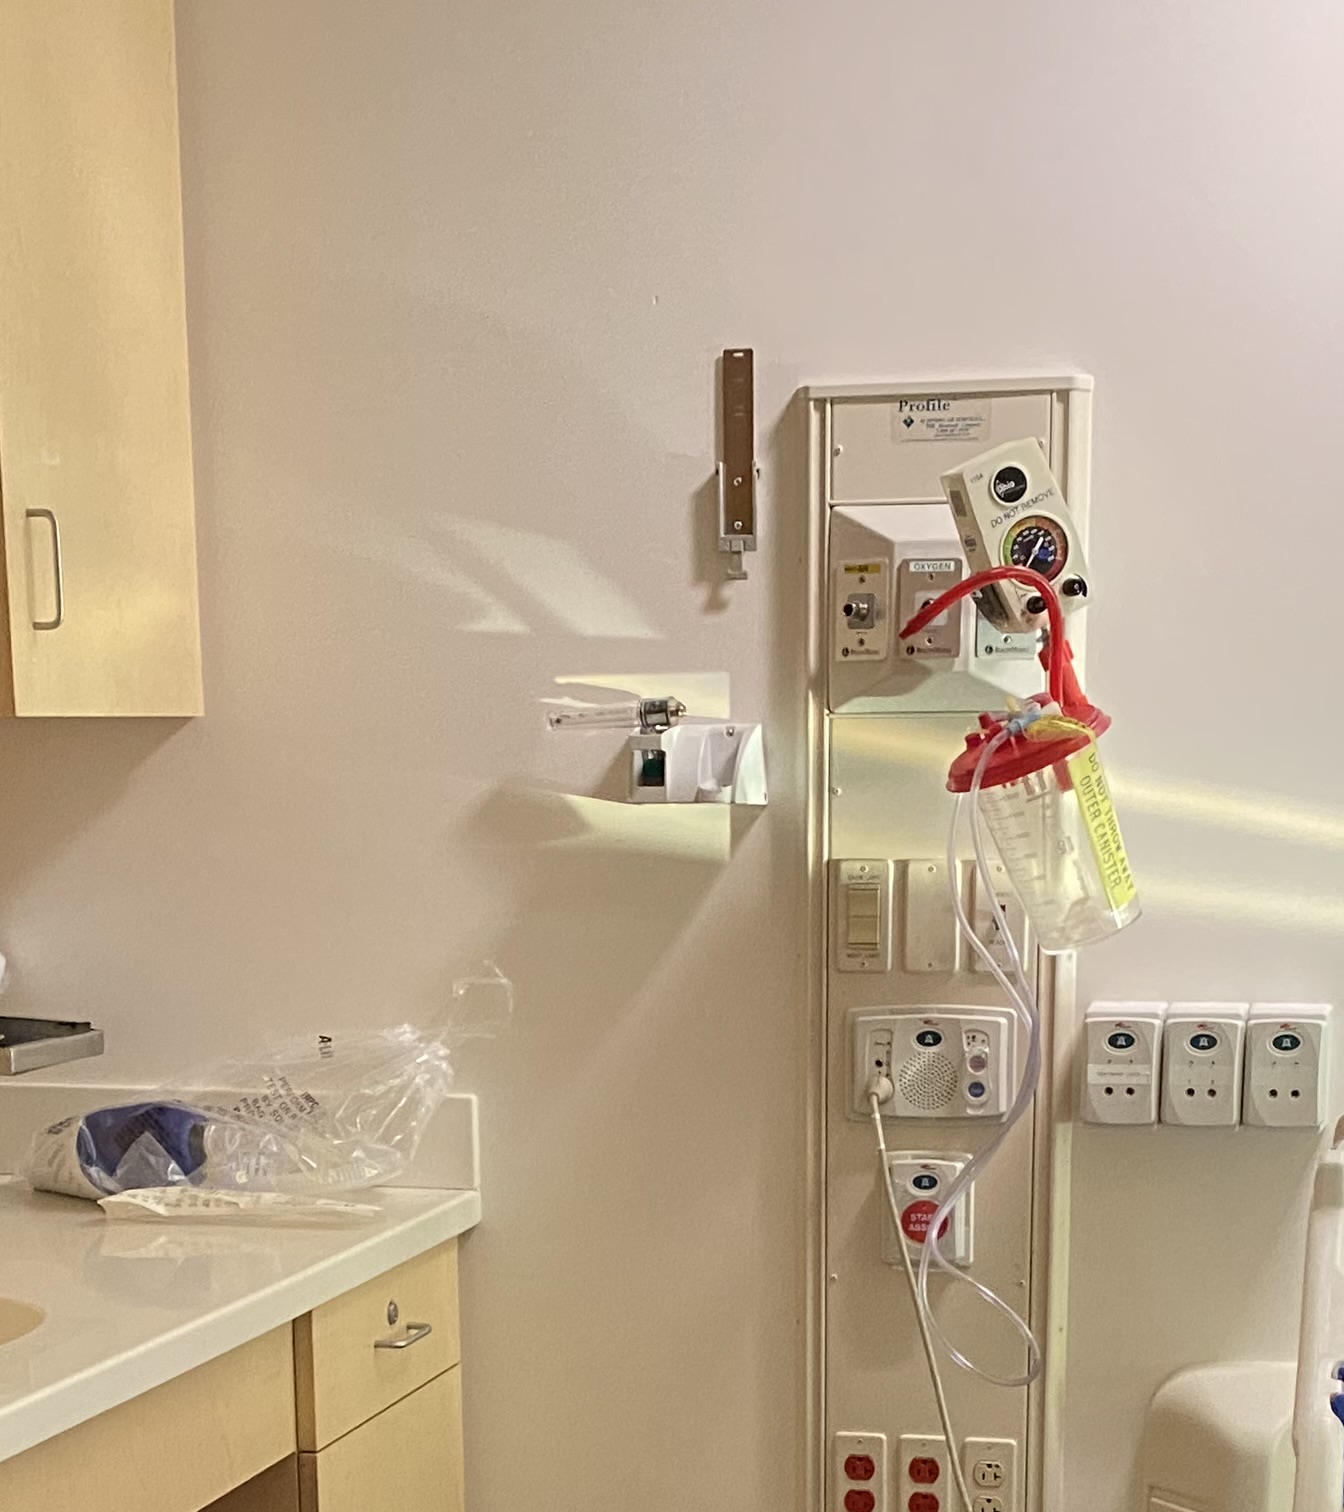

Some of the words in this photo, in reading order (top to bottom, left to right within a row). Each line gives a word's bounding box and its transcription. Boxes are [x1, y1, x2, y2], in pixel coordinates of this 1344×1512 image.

[898, 398, 950, 412] Profile
[990, 516, 1004, 529] DO
[1003, 504, 1020, 520] NOT
[1020, 486, 1055, 510] REMOVE
[913, 562, 952, 571] OXYGEN
[1080, 774, 1102, 822] OUTER
[1098, 822, 1123, 890] CANISTER
[1088, 752, 1100, 772] DO
[1094, 774, 1108, 804] NOT
[1107, 808, 1123, 853] THROW
[1119, 856, 1135, 891] AWAY
